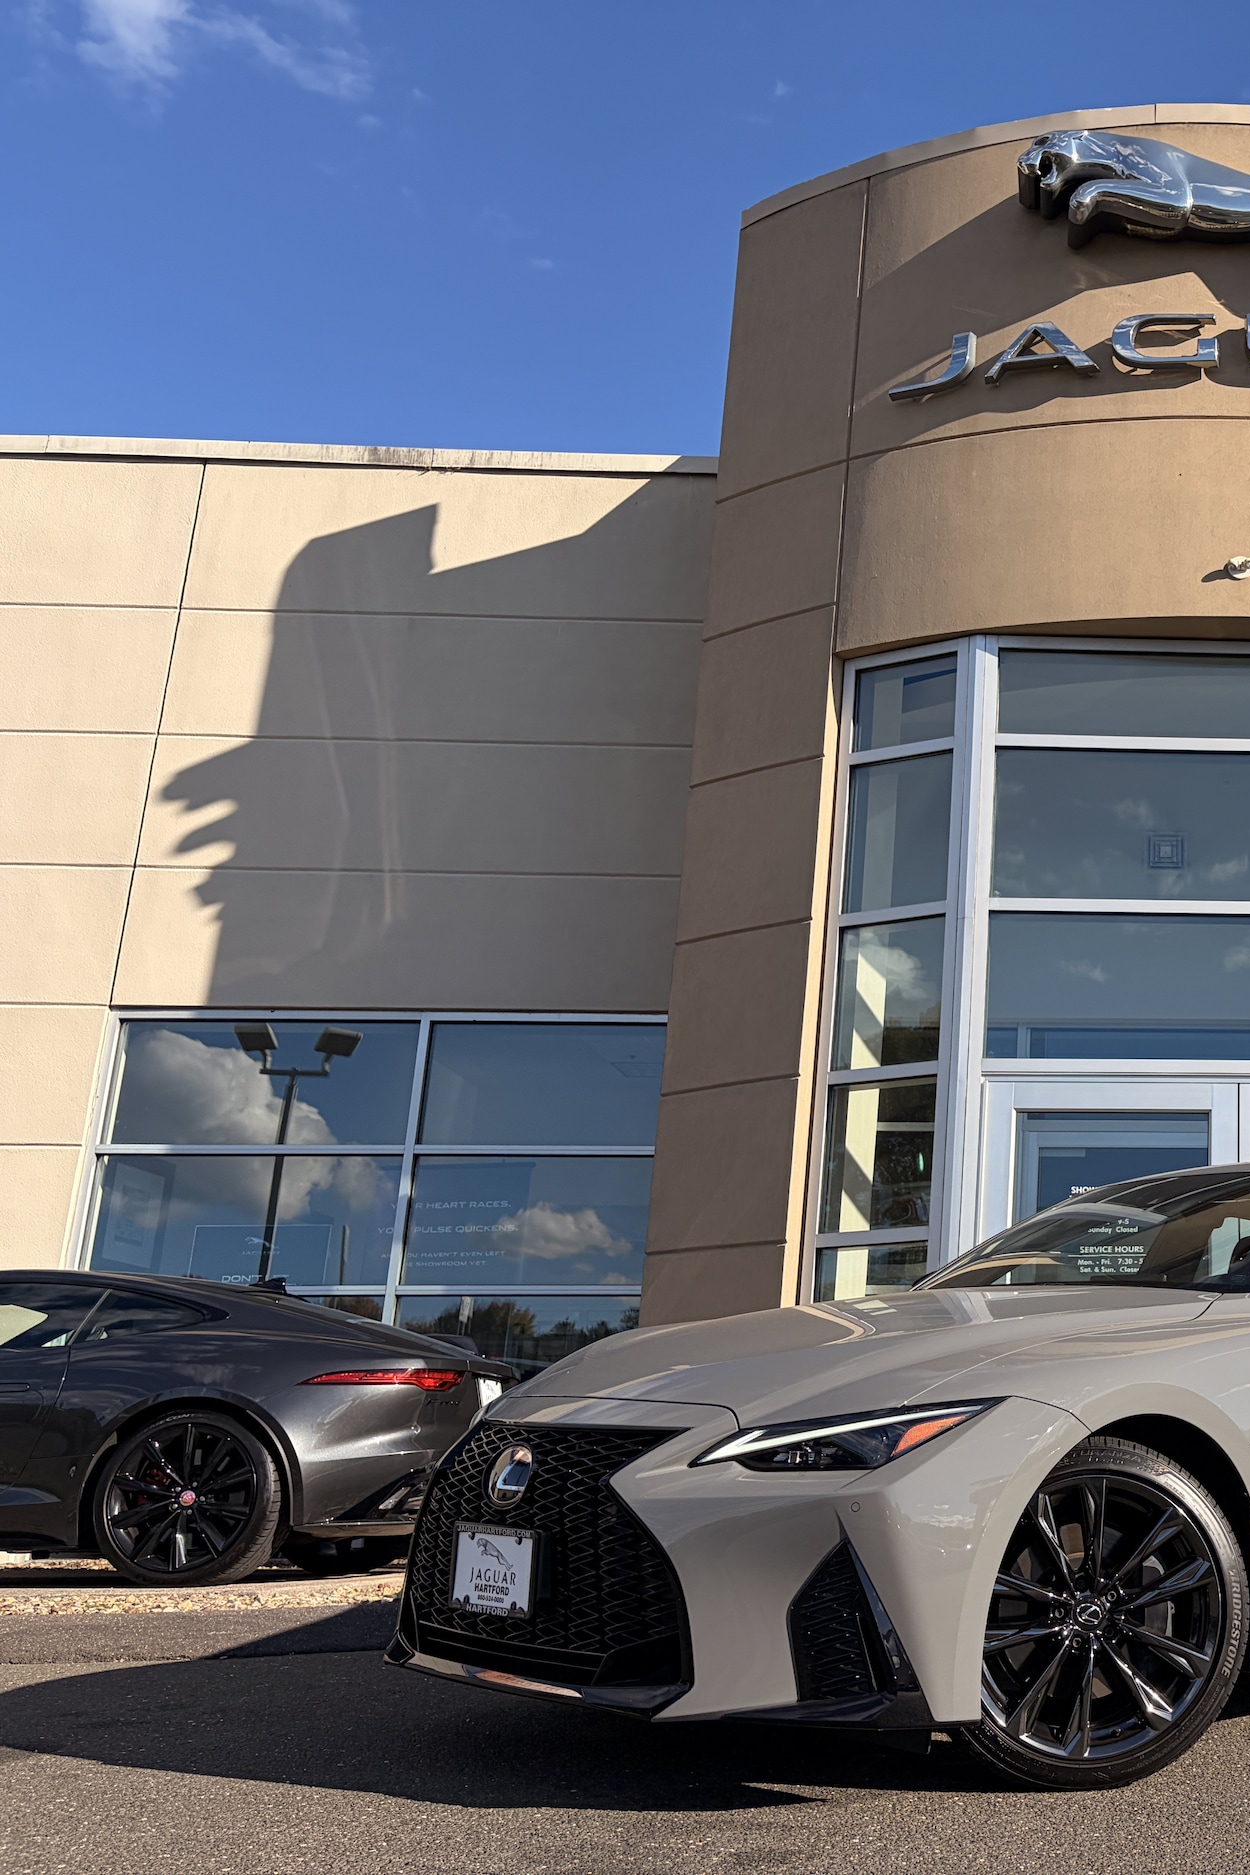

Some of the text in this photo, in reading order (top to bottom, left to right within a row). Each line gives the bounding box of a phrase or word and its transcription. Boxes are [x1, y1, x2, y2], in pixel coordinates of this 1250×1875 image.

[391, 1200, 512, 1210] YR HEART RACES.
[414, 1225, 452, 1233] PULSE
[455, 1224, 518, 1233] QUICKENS.
[1079, 1245, 1145, 1254] SERVICE HOURS
[457, 1524, 532, 1538] JAGUARHARTFORD.COM
[469, 1567, 517, 1586] JAGUAR
[474, 1582, 510, 1596] HARTFORD
[465, 1603, 509, 1617] HARTFORD
